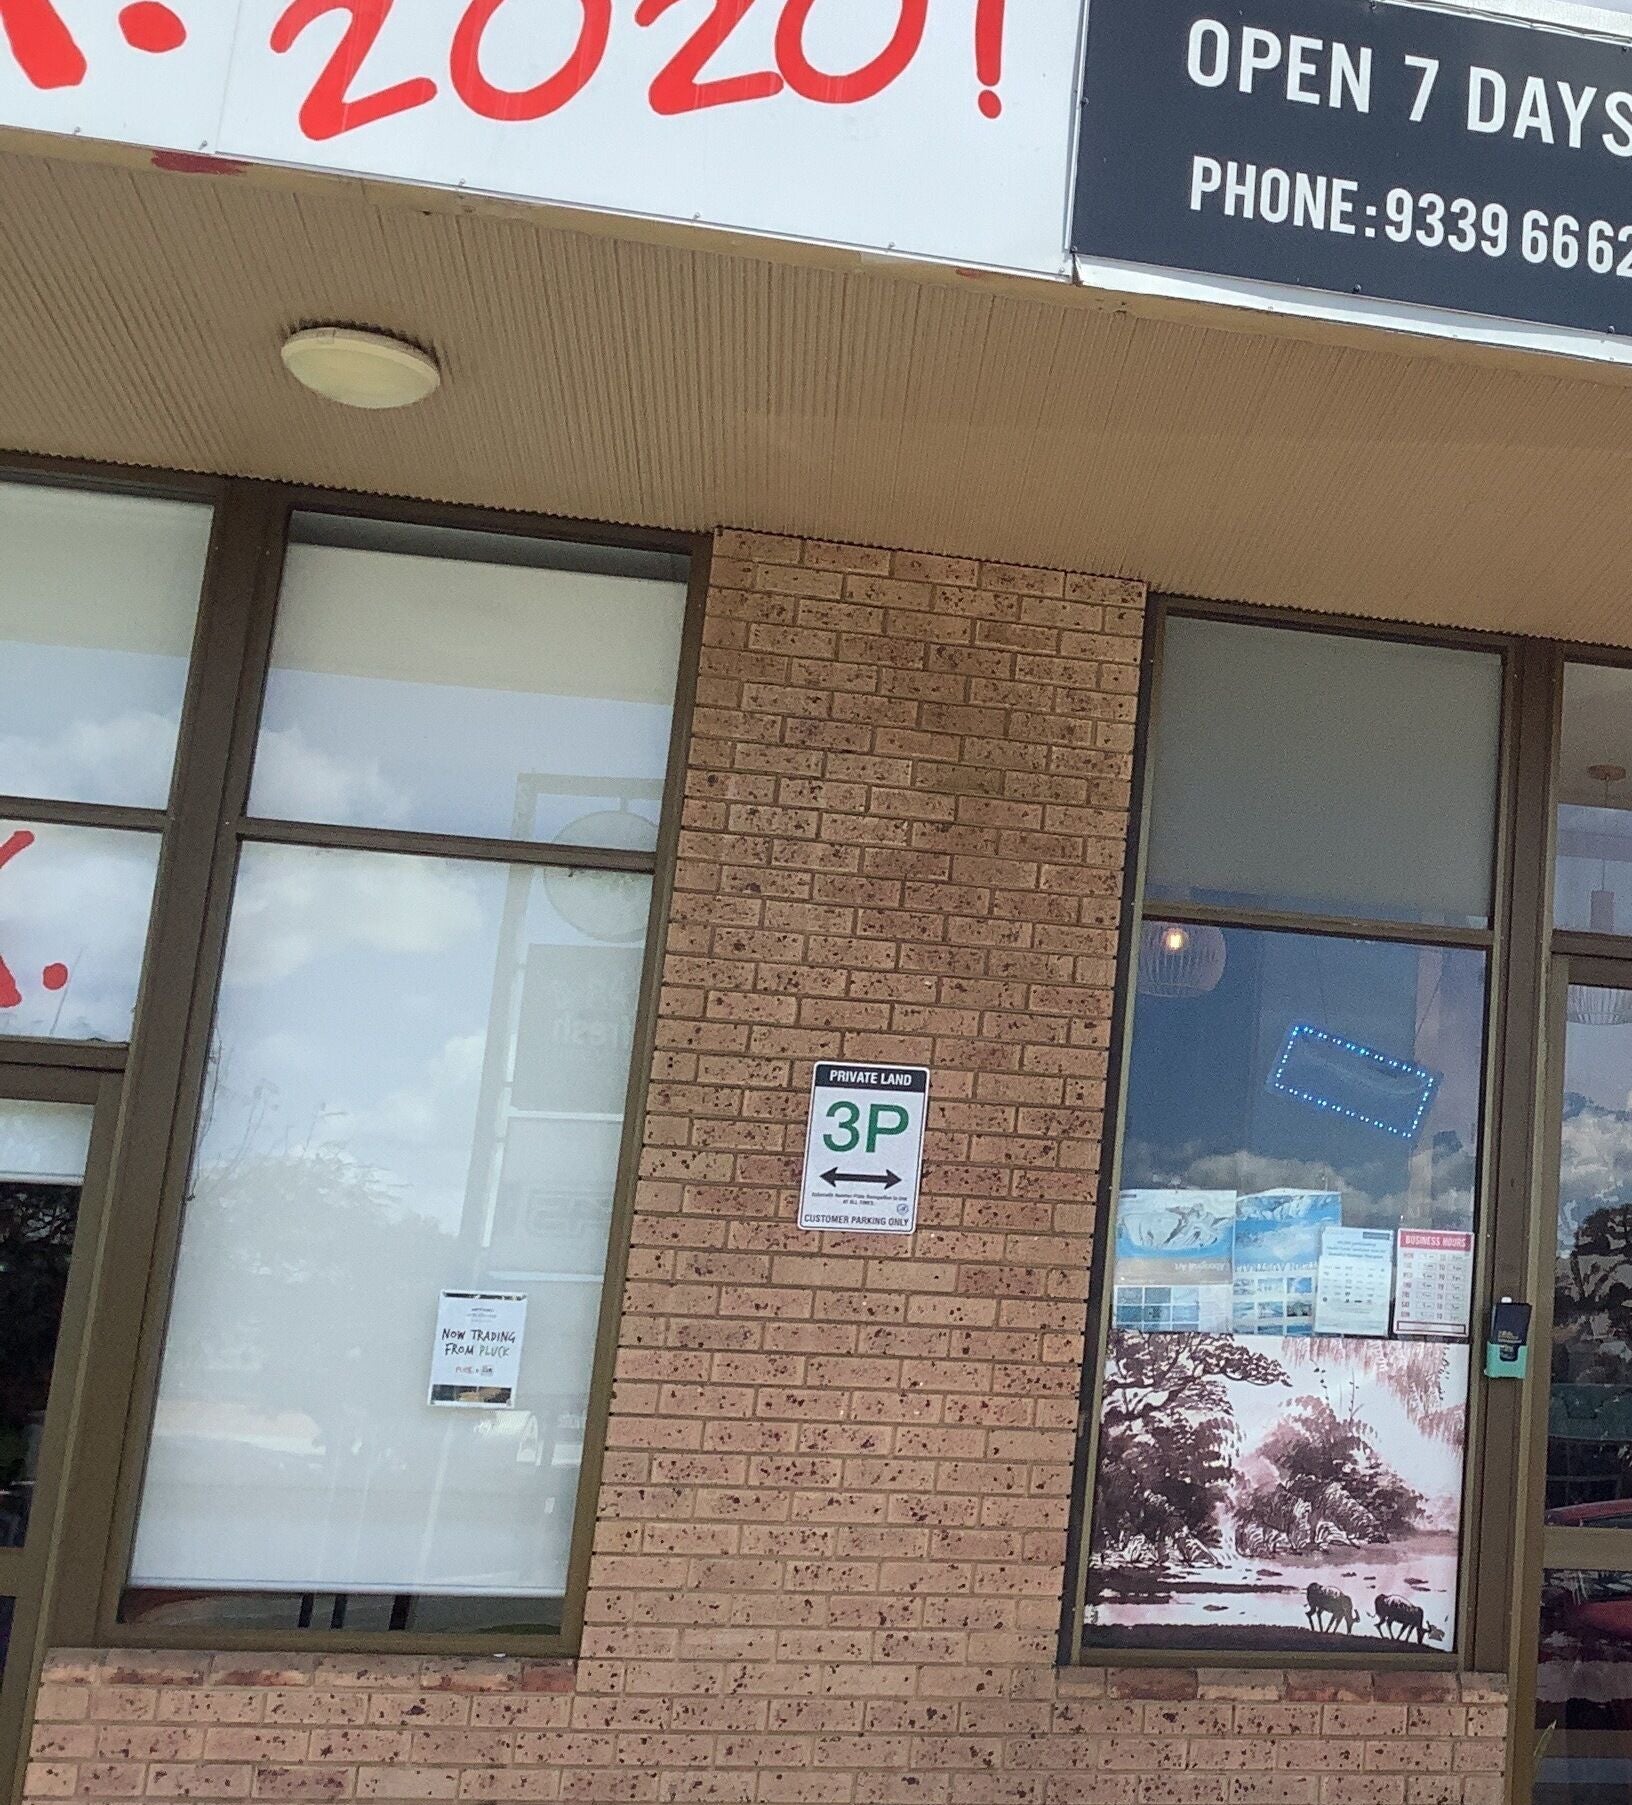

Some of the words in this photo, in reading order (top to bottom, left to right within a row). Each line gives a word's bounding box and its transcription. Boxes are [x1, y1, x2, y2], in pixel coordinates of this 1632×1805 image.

[1187, 18, 1372, 114] OPEN
[1405, 54, 1440, 122] 7
[829, 1070, 878, 1085] PRIVATE
[881, 1073, 912, 1086] LAND
[823, 1101, 909, 1153] 3P
[804, 1214, 849, 1224] CUSTOMER
[851, 1216, 886, 1226] PARKING
[888, 1218, 909, 1226] ONLY
[1405, 1235, 1440, 1246] BUSINESS
[471, 1329, 516, 1344] TRADING
[445, 1342, 474, 1356] FROM
[479, 1345, 511, 1359] PLUCK
